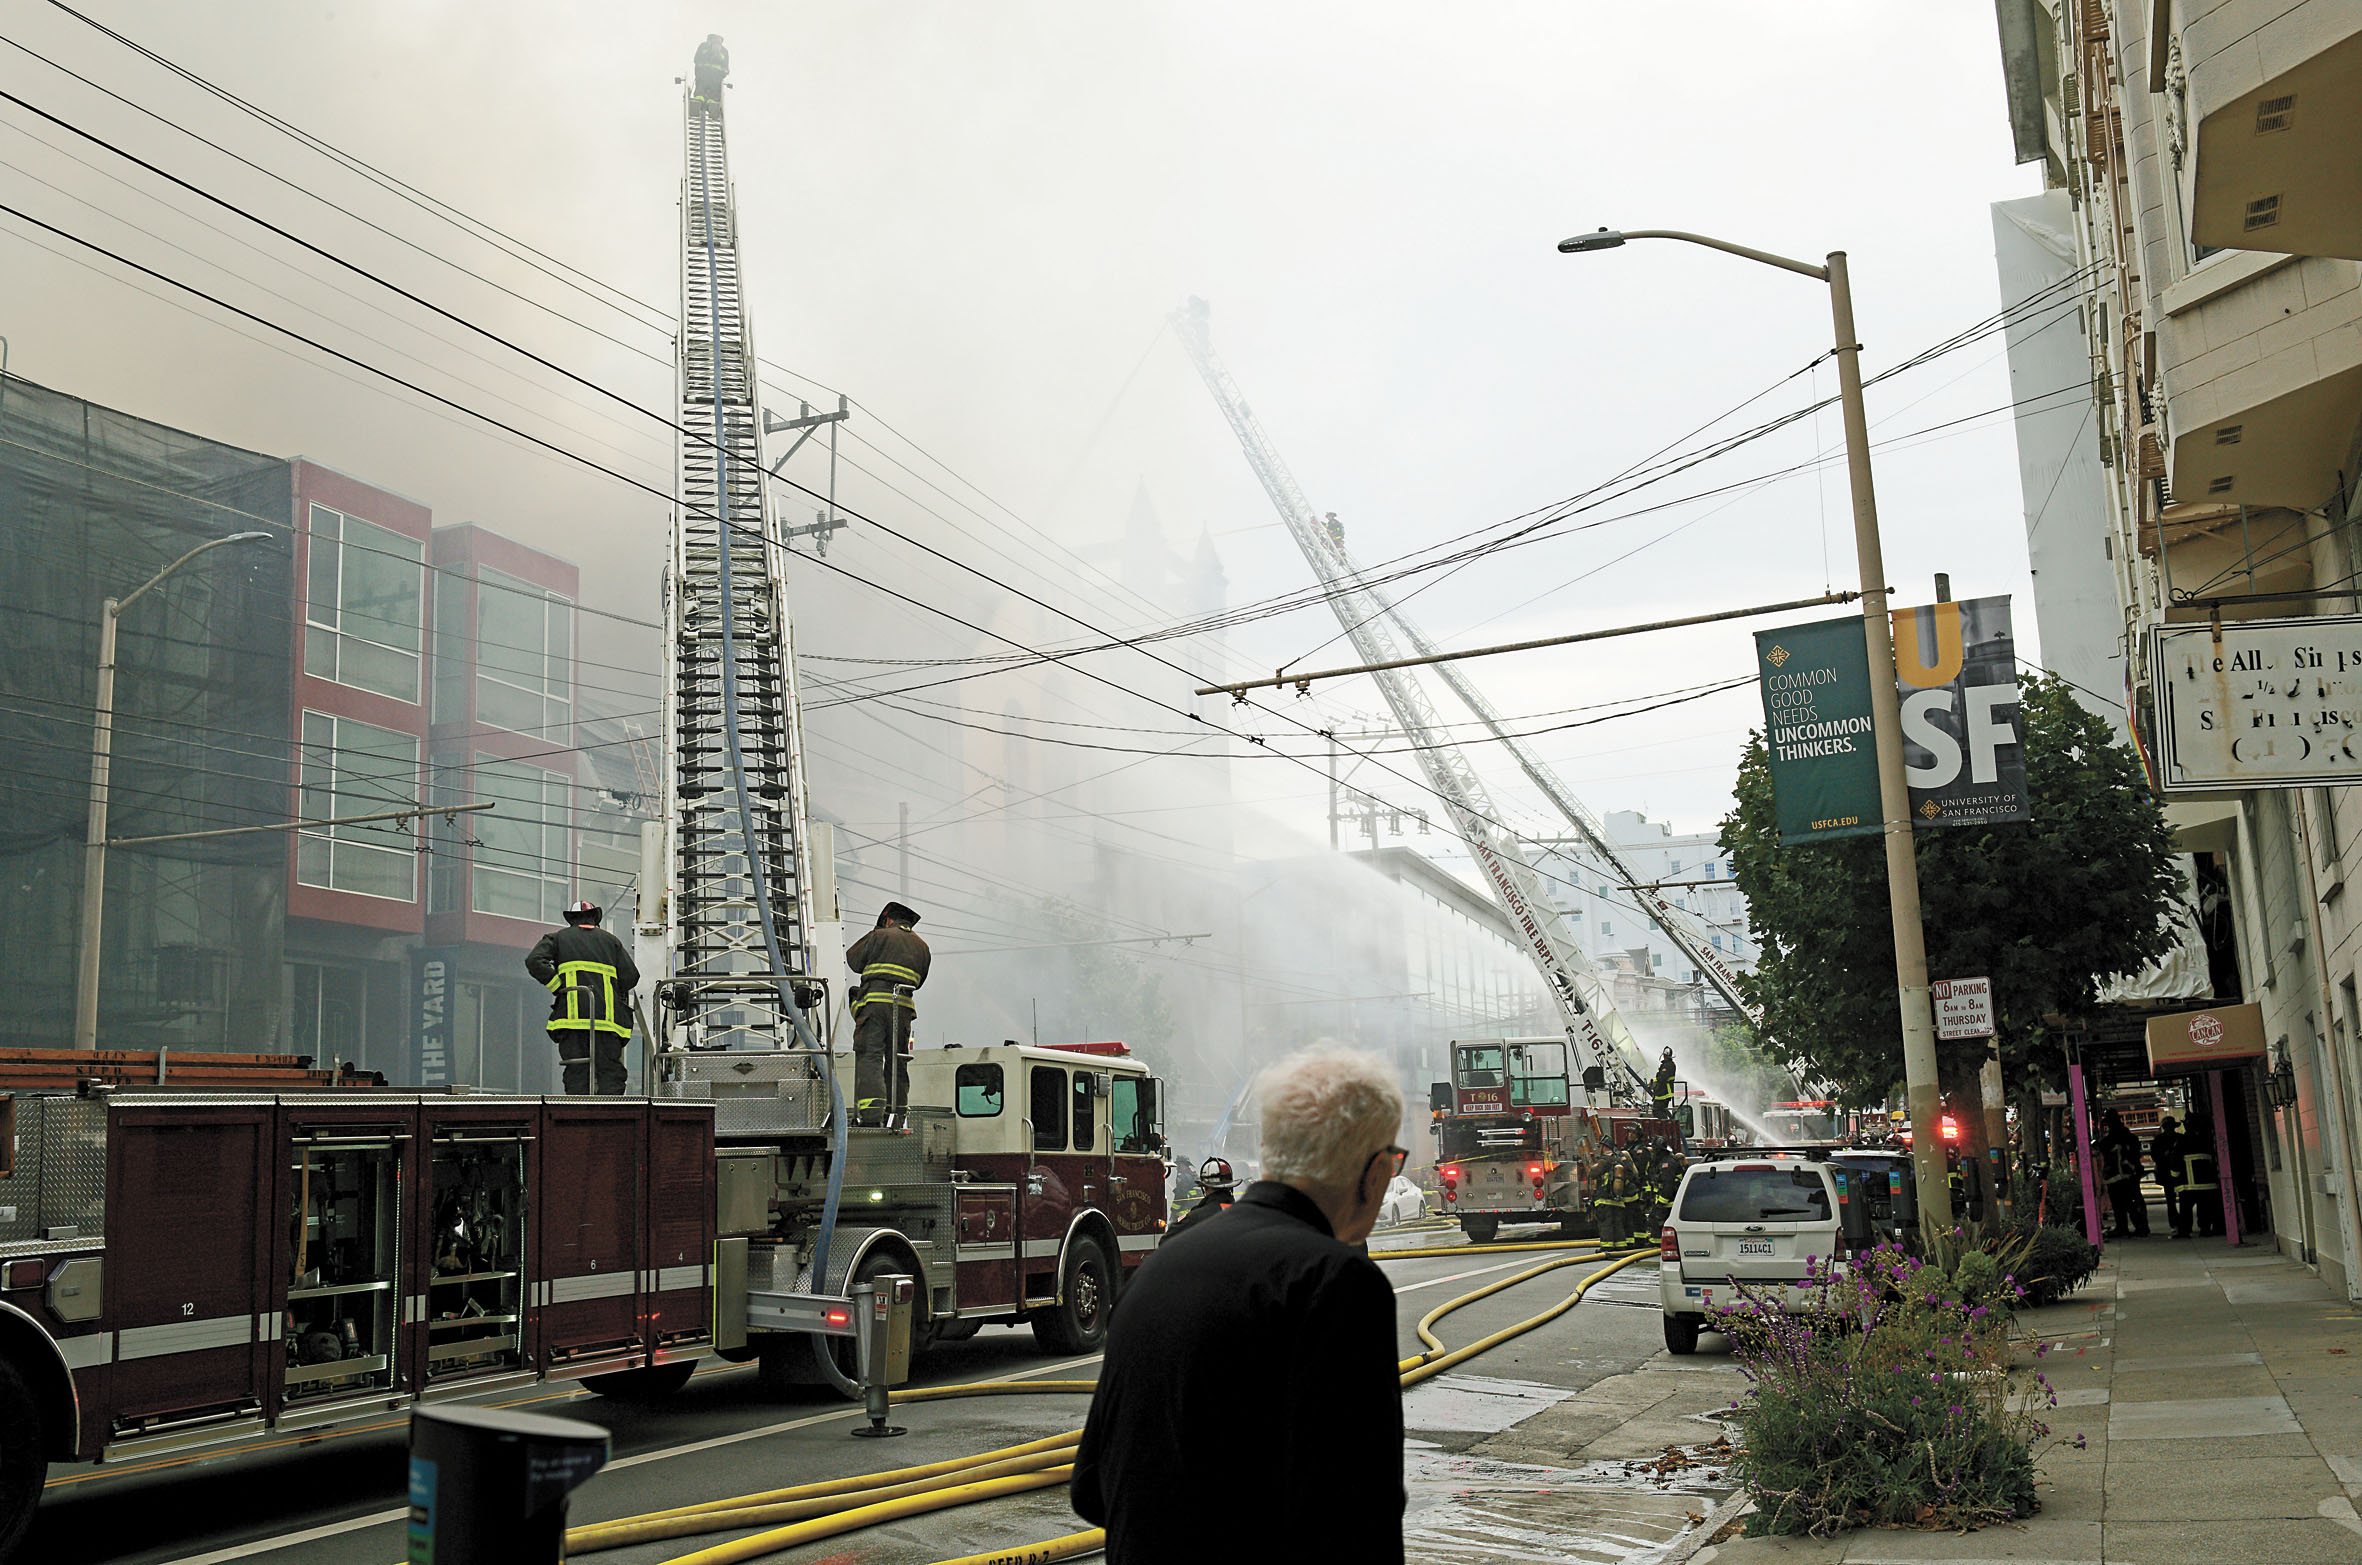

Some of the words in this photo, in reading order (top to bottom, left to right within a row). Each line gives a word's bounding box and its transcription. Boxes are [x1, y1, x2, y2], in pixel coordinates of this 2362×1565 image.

[1891, 601, 1964, 688] U
[1769, 667, 1837, 691] COMMON
[1771, 688, 1813, 709] GOOD
[1772, 705, 1818, 726] NEEDS
[1775, 716, 1872, 744] UNCOMMON
[1900, 683, 2020, 788] SF
[1776, 736, 1857, 761] THINKERS.
[1941, 795, 2000, 807] UNIVERSITY
[2003, 794, 2016, 802] OF
[1942, 809, 1961, 818] SAN
[1964, 804, 2018, 816] FRANCISCO
[1811, 815, 1859, 830] USFCA.EDU
[1477, 840, 1494, 862] SAN
[1488, 860, 1525, 916] FRANCISCO
[1520, 914, 1539, 940] FIRE
[1533, 937, 1555, 969] DEPT.
[1701, 946, 1716, 962] SAN
[422, 961, 446, 1030] YARD
[1935, 983, 1950, 999] NO
[1953, 982, 1988, 997] PARKING
[1942, 1013, 1986, 1026] THURSDAY
[1581, 1019, 1604, 1051] T-16
[1942, 1029, 1962, 1037] STREET
[421, 1035, 446, 1086] THE
[1487, 1092, 1498, 1102] 16
[678, 1251, 684, 1262] 4
[1739, 1243, 1772, 1254] 15114C1
[590, 1259, 597, 1270] 6
[181, 1302, 194, 1315] 12
